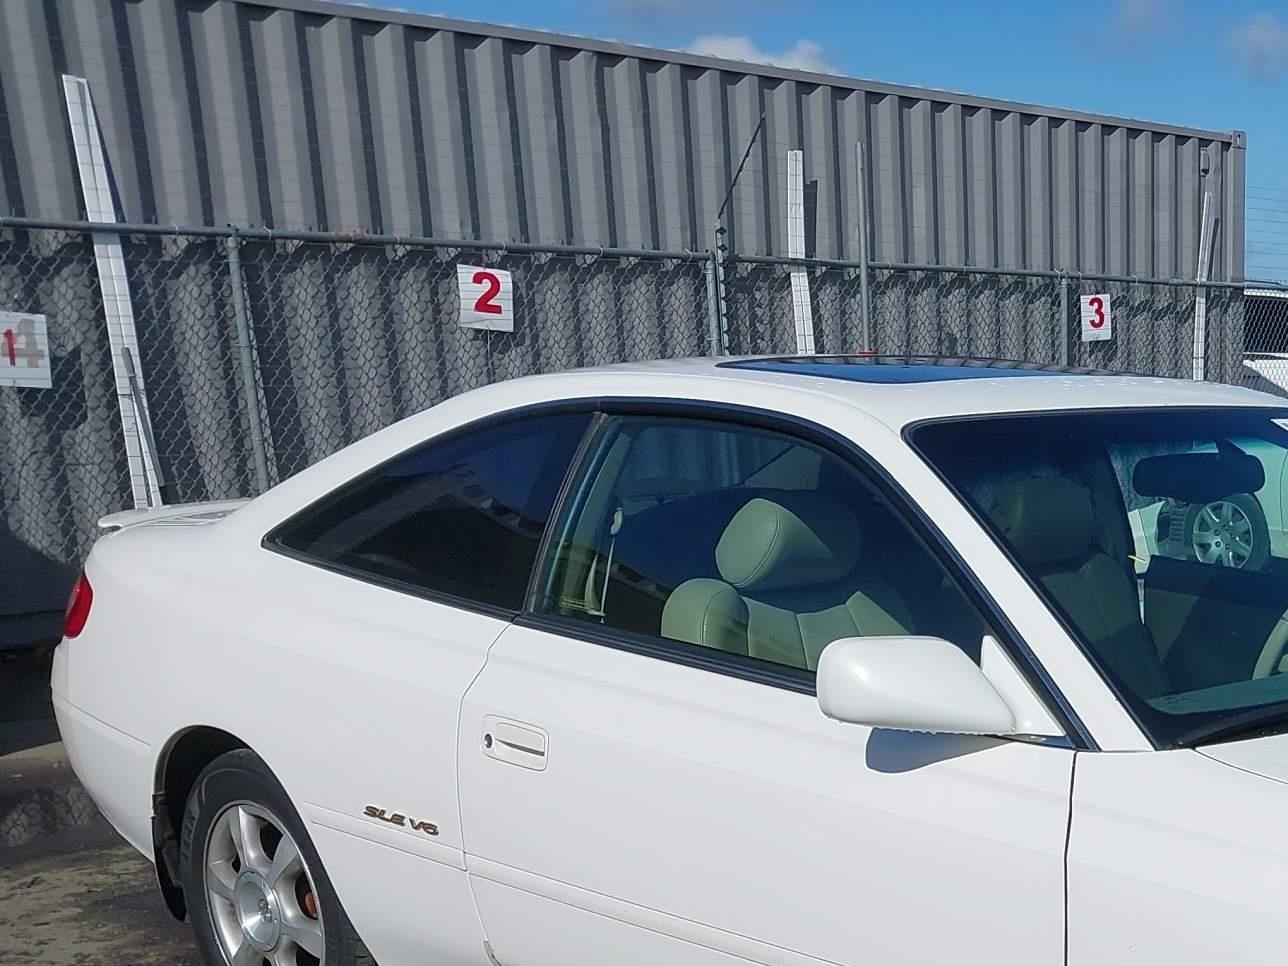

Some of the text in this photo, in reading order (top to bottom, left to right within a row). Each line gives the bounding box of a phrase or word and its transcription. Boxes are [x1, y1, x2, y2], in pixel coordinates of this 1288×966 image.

[472, 271, 503, 315] 2
[1088, 296, 1106, 329] 3
[363, 805, 440, 836] SLE V6
